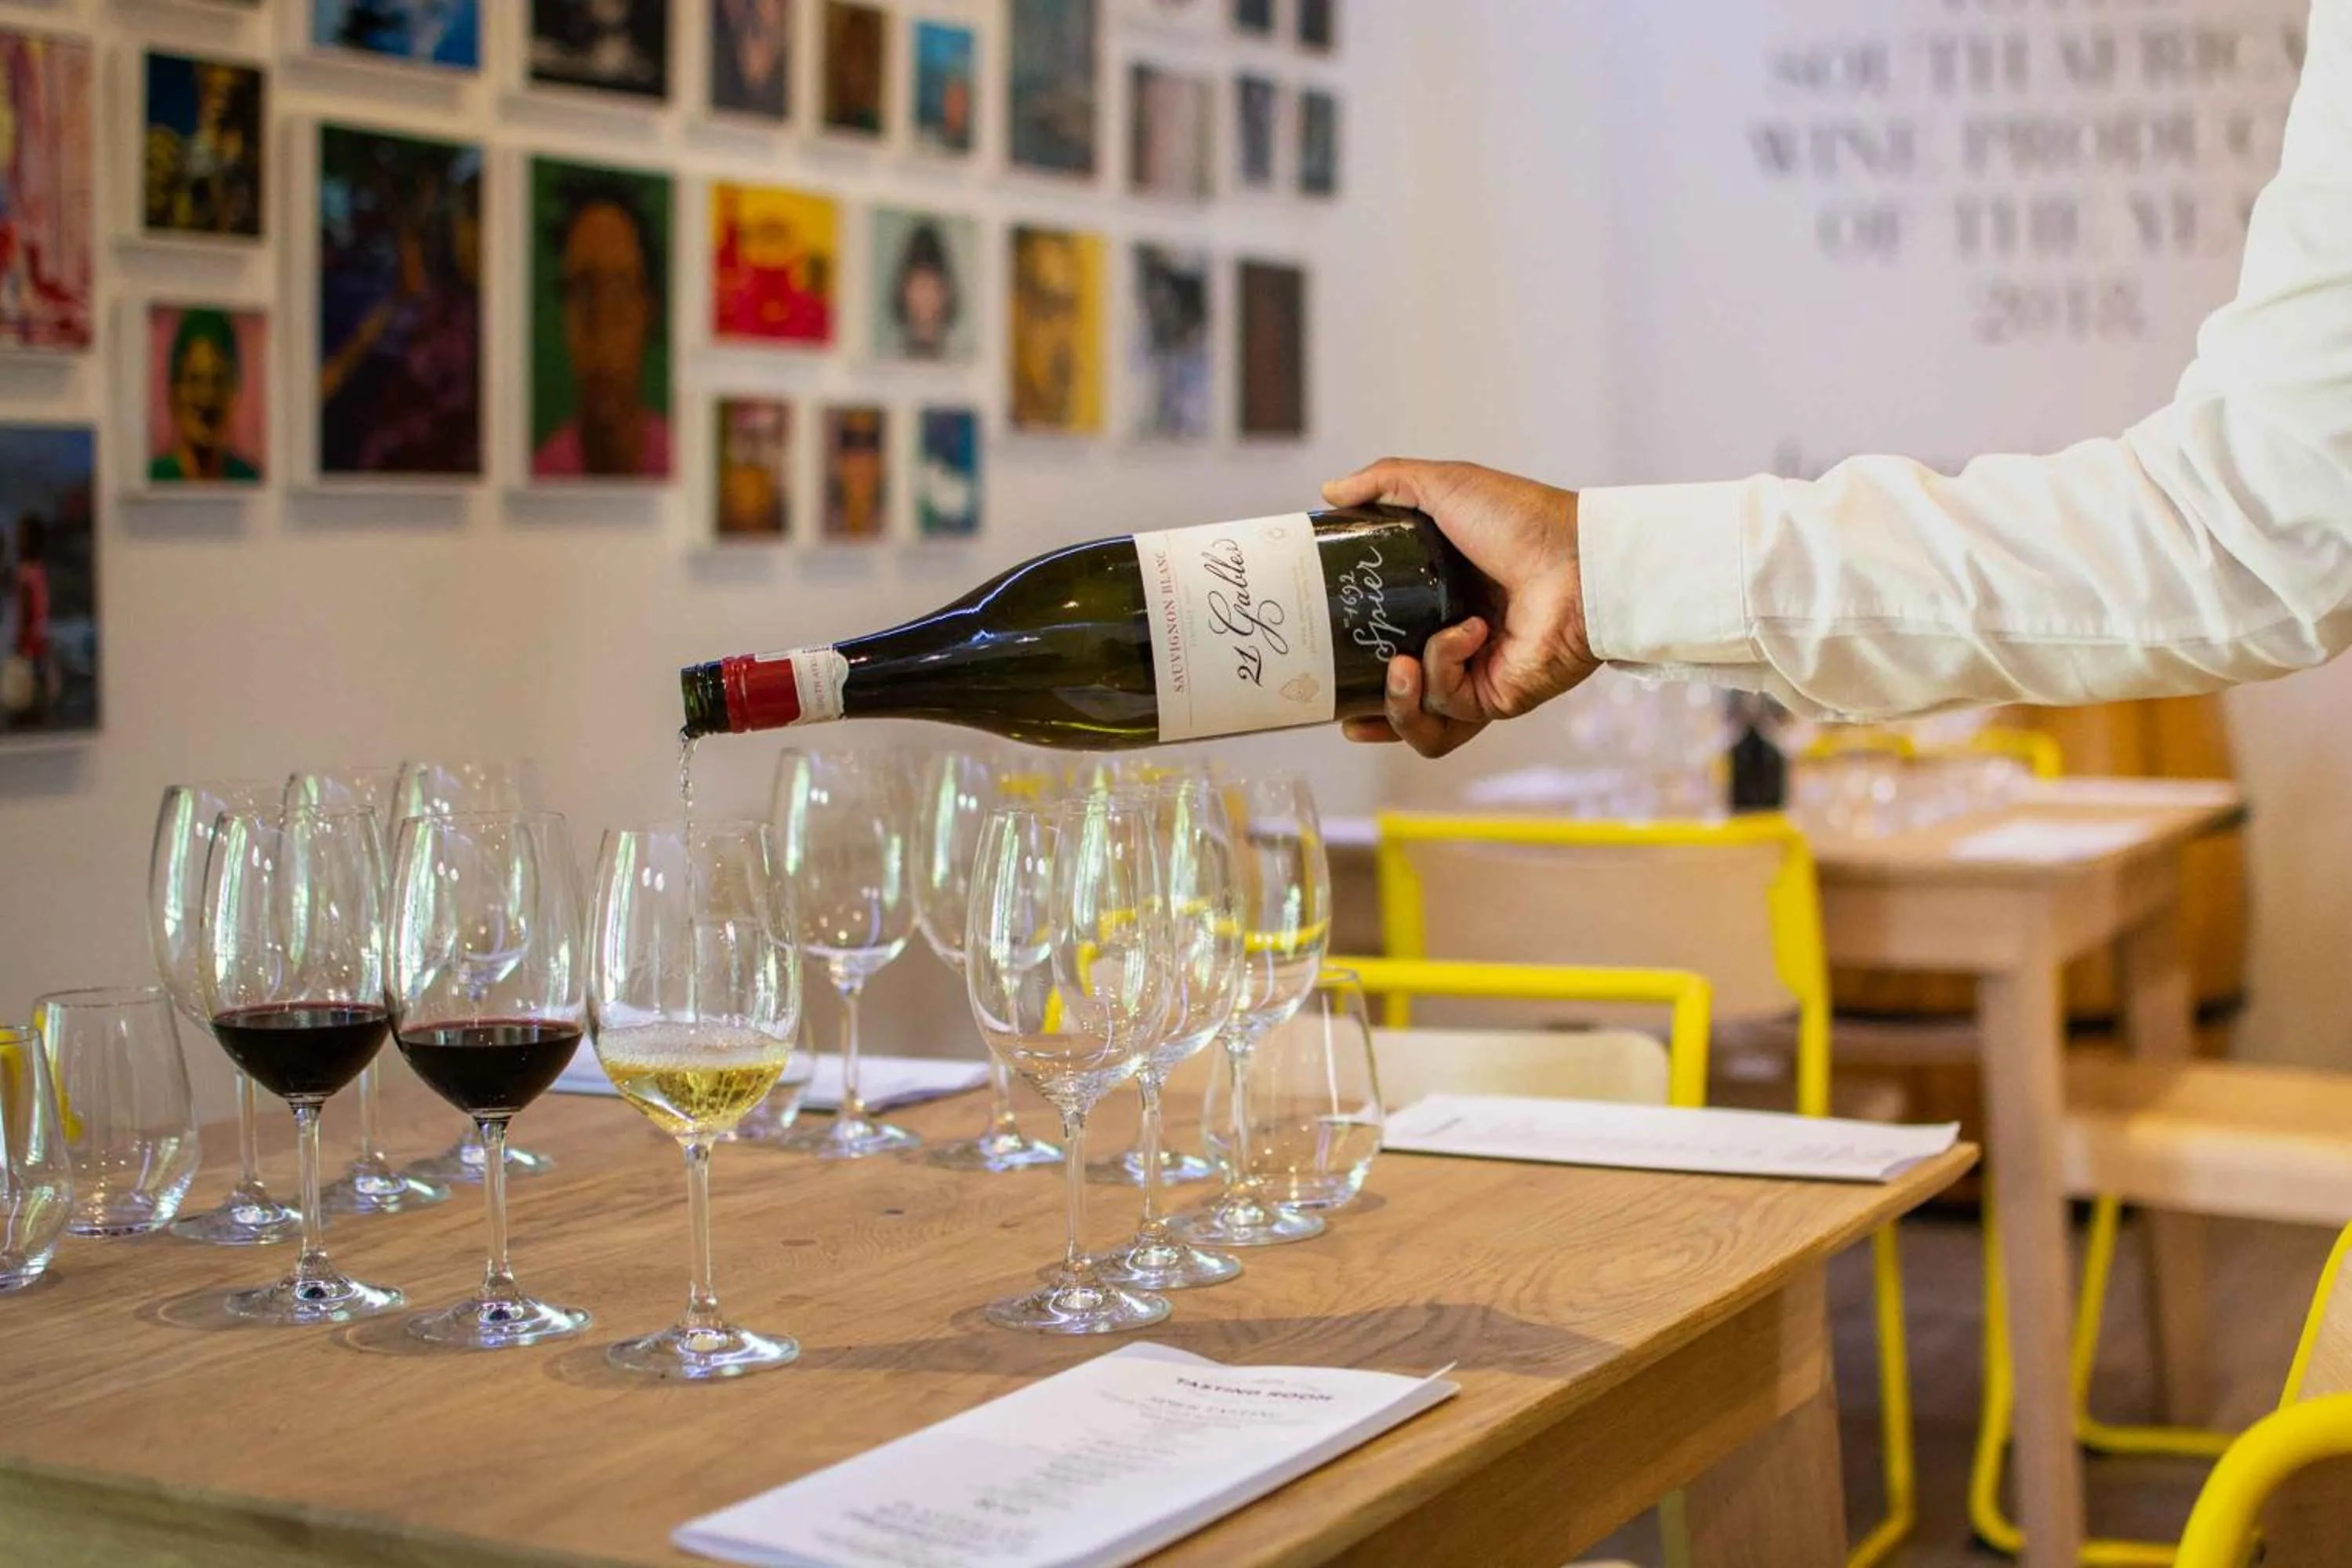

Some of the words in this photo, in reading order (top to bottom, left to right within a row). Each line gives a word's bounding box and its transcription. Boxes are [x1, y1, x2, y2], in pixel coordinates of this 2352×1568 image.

[1156, 550, 1175, 595] BLANC
[1201, 537, 1290, 655] Gables
[1352, 545, 1408, 663] Spier
[1163, 598, 1184, 693] SAUVIGNON
[1233, 644, 1263, 688] 21
